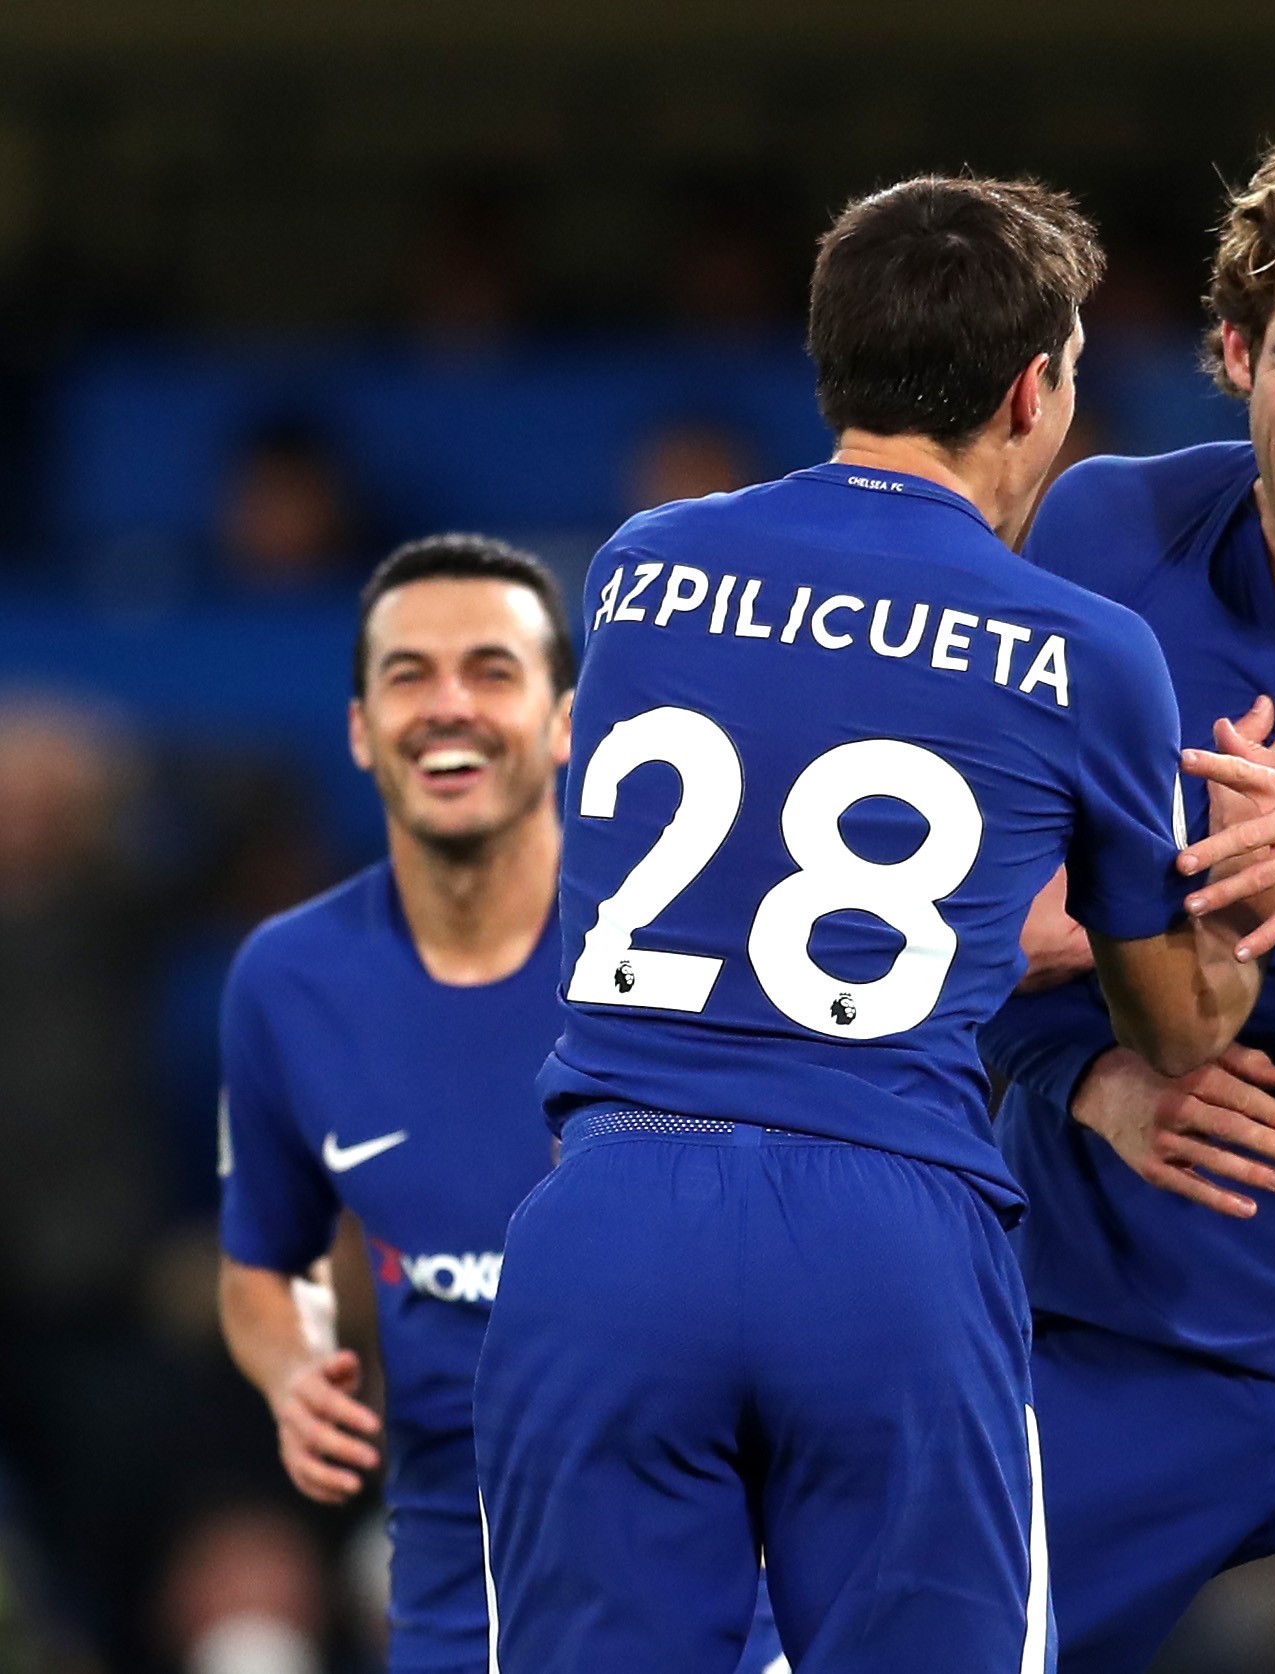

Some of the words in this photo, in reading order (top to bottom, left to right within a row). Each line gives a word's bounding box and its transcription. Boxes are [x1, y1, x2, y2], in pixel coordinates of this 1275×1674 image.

[847, 476, 887, 490] CHELSEA
[890, 482, 905, 492] FC
[594, 562, 1071, 708] AZPILICUETA
[566, 705, 985, 1041] 28
[400, 1252, 504, 1302] YOKO
